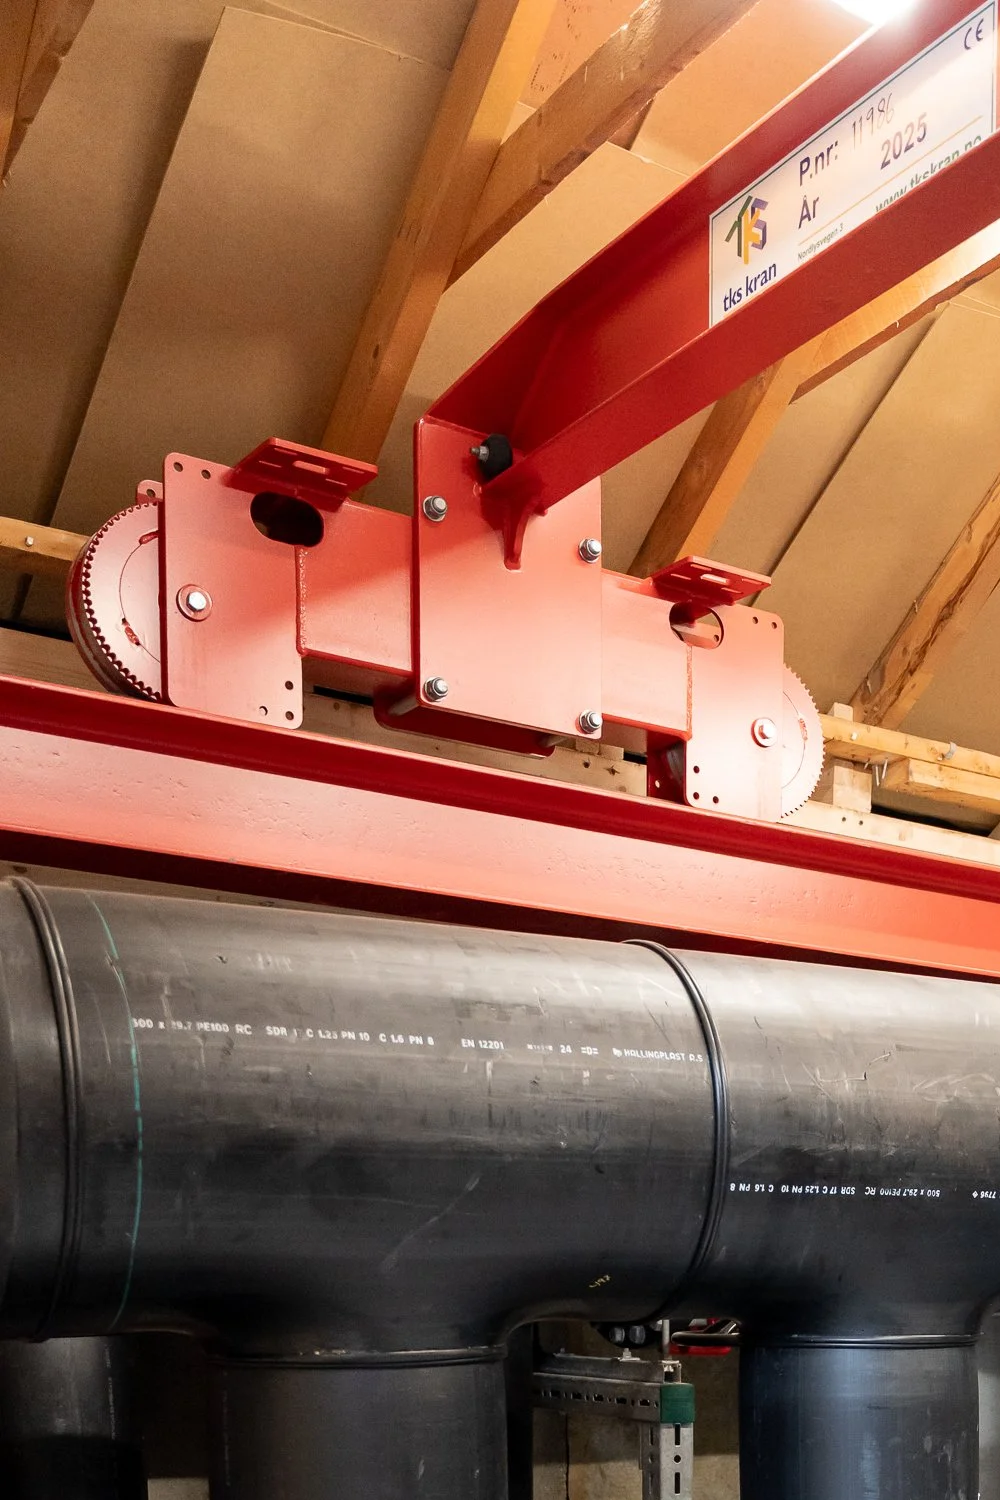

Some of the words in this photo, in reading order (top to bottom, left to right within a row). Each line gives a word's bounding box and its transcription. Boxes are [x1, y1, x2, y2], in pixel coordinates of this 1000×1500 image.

[799, 140, 839, 187] P.nr:
[798, 194, 820, 230] År
[880, 111, 928, 170] 2025
[875, 135, 982, 213] wwwtkskranno
[723, 288, 743, 312] tks
[745, 263, 777, 298] kran
[196, 1021, 230, 1033] PE100
[234, 1023, 253, 1035] RC
[265, 1025, 288, 1037] SDR
[341, 1030, 356, 1041] PN
[358, 1032, 370, 1042] 10
[390, 1034, 405, 1044] 1.6
[408, 1035, 424, 1045] PN
[461, 1038, 476, 1048] EN
[478, 1040, 505, 1050] 12201
[559, 1044, 573, 1054] 24
[738, 1183, 751, 1192] PN
[754, 1183, 765, 1193] 1.6
[780, 1184, 790, 1193] 10
[791, 1185, 803, 1194] PN
[804, 1185, 820, 1194] 1.25
[829, 1186, 837, 1195] 17
[840, 1186, 856, 1195] SDR
[864, 1186, 877, 1196] RC
[879, 1187, 902, 1197] PE100
[902, 1188, 918, 1197] 29.7
[926, 1189, 941, 1198] 500
